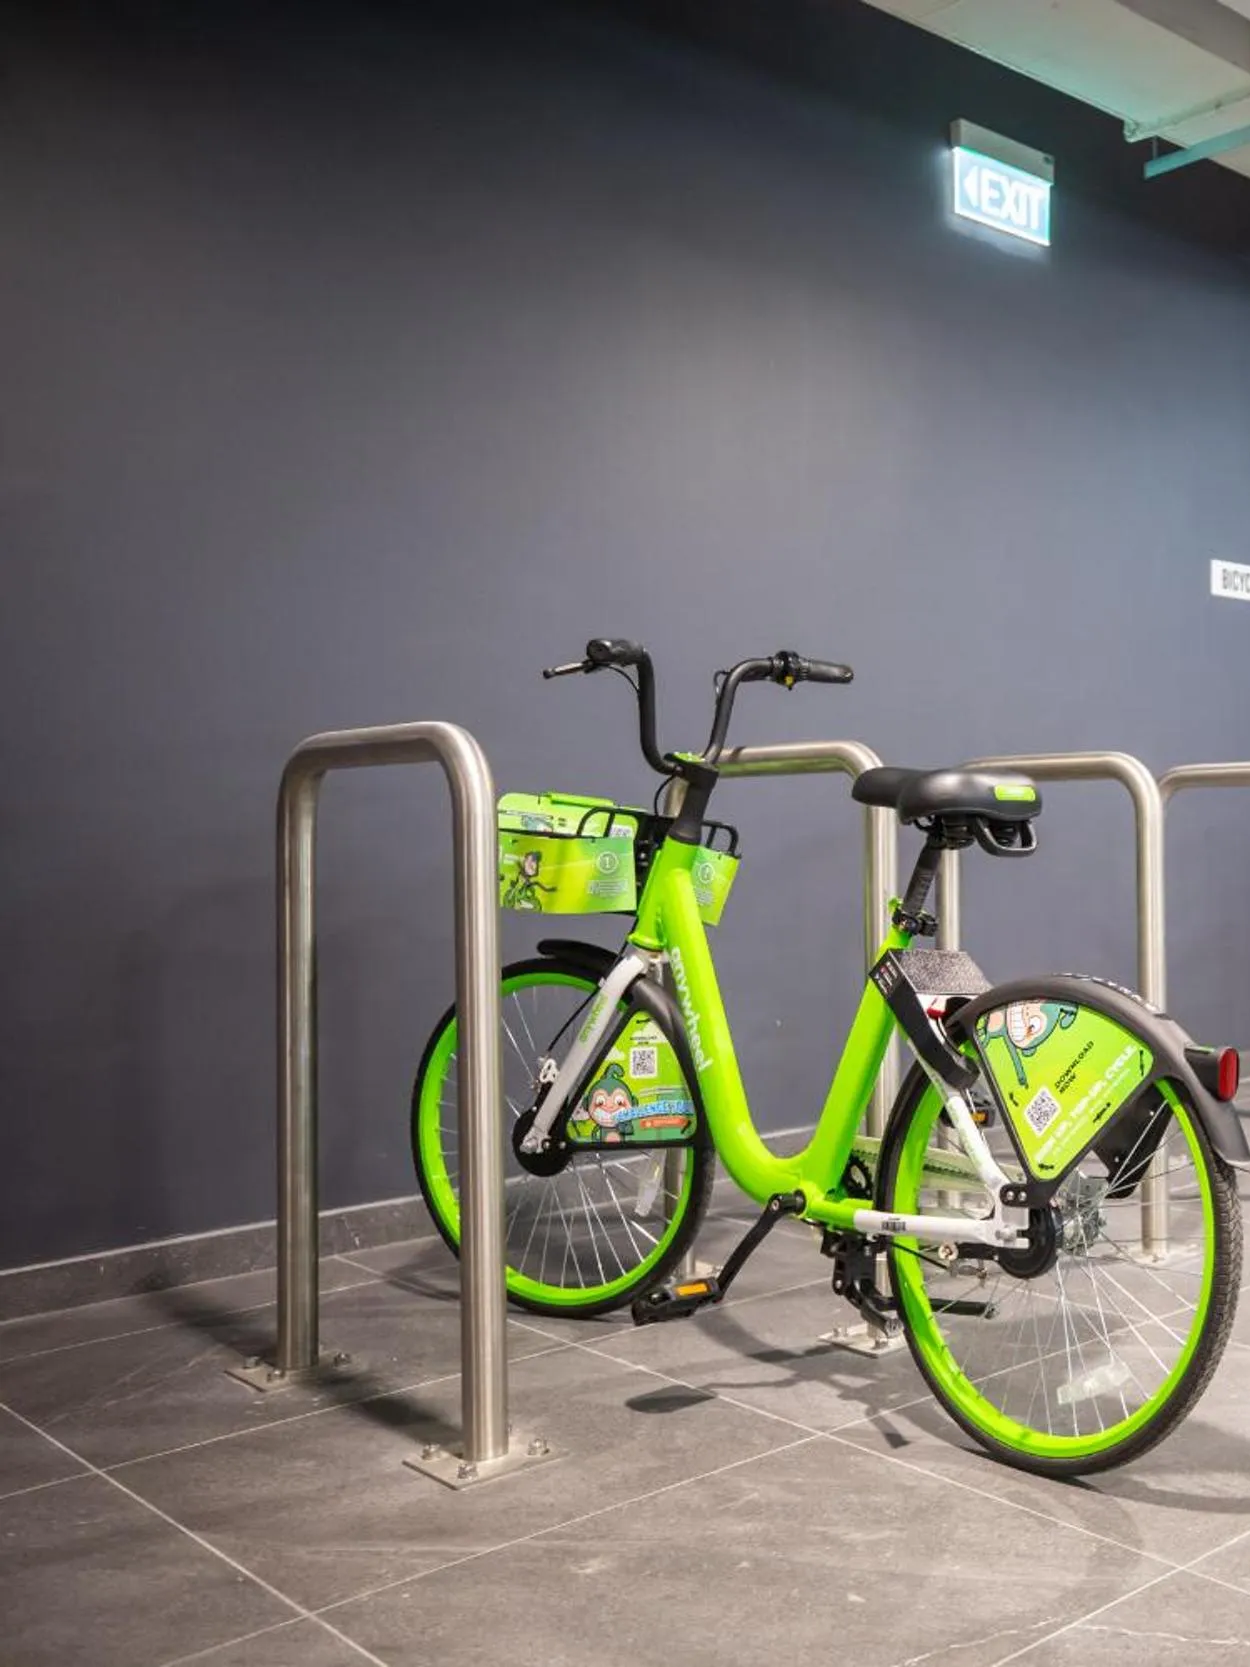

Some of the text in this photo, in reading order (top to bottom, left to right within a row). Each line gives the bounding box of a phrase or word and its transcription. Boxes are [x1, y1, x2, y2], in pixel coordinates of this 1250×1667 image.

[980, 166, 1045, 231] EXIT
[1054, 1040, 1095, 1090] DOWNLOAD
[1059, 1072, 1077, 1094] NOW
